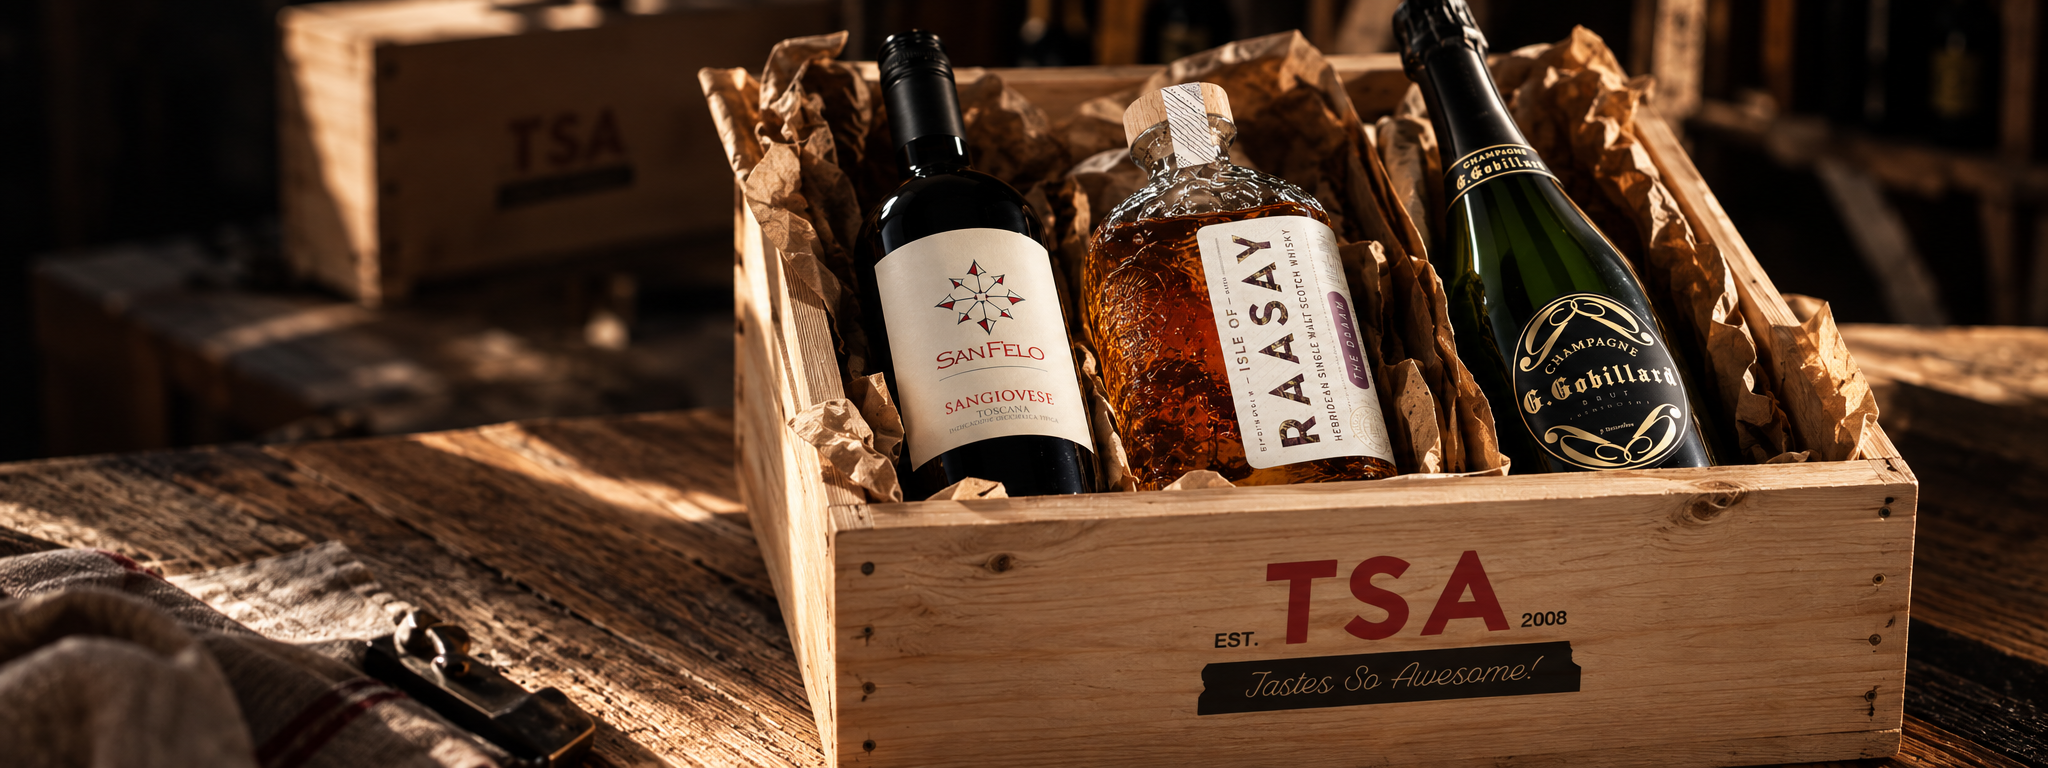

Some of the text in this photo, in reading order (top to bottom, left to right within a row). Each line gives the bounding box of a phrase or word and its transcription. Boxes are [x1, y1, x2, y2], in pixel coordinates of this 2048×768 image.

[508, 107, 627, 171] TSA
[1281, 229, 1299, 267] WHISKY
[1292, 270, 1309, 309] SCOTCH
[1226, 309, 1240, 329] OF
[1231, 234, 1321, 448] RAASAY
[1232, 336, 1251, 372] ISLE
[1544, 337, 1639, 375] CHAMPAGNE
[1310, 342, 1327, 379] SINGLE
[1349, 354, 1363, 380] THE
[944, 389, 1055, 415] SANGIOVESE
[976, 405, 1031, 418] TOSCANA
[1320, 382, 1343, 442] HEBRIDEAN
[1214, 550, 1568, 648] EST. TSA 2008
[1245, 655, 1545, 698] Tastes So Awesome!
